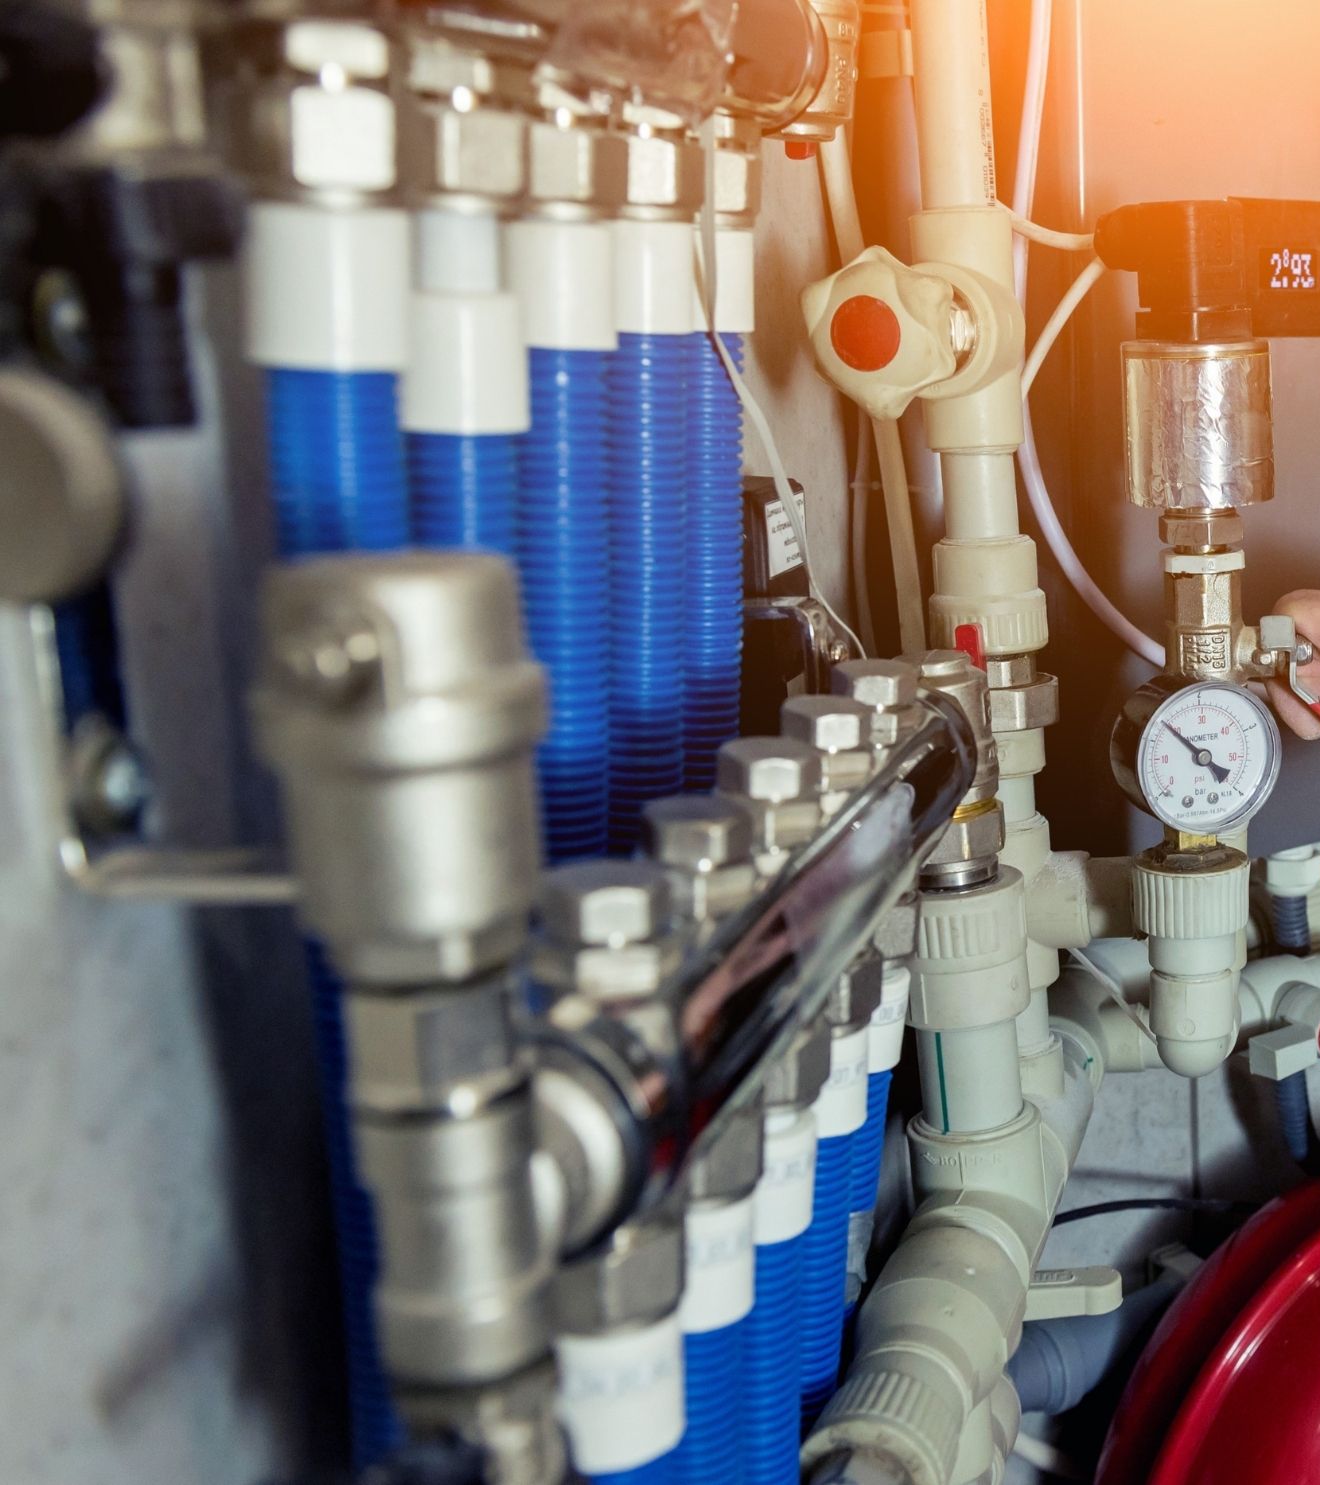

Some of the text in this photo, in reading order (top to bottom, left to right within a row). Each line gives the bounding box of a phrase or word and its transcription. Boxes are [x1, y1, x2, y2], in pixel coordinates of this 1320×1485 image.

[1198, 715, 1206, 725] 30
[1220, 726, 1230, 736] 40
[1183, 732, 1218, 744] ANOMETER
[1161, 754, 1169, 764] 10
[1228, 752, 1237, 762] 50
[1194, 775, 1205, 784] psi
[1194, 788, 1205, 796] bar
